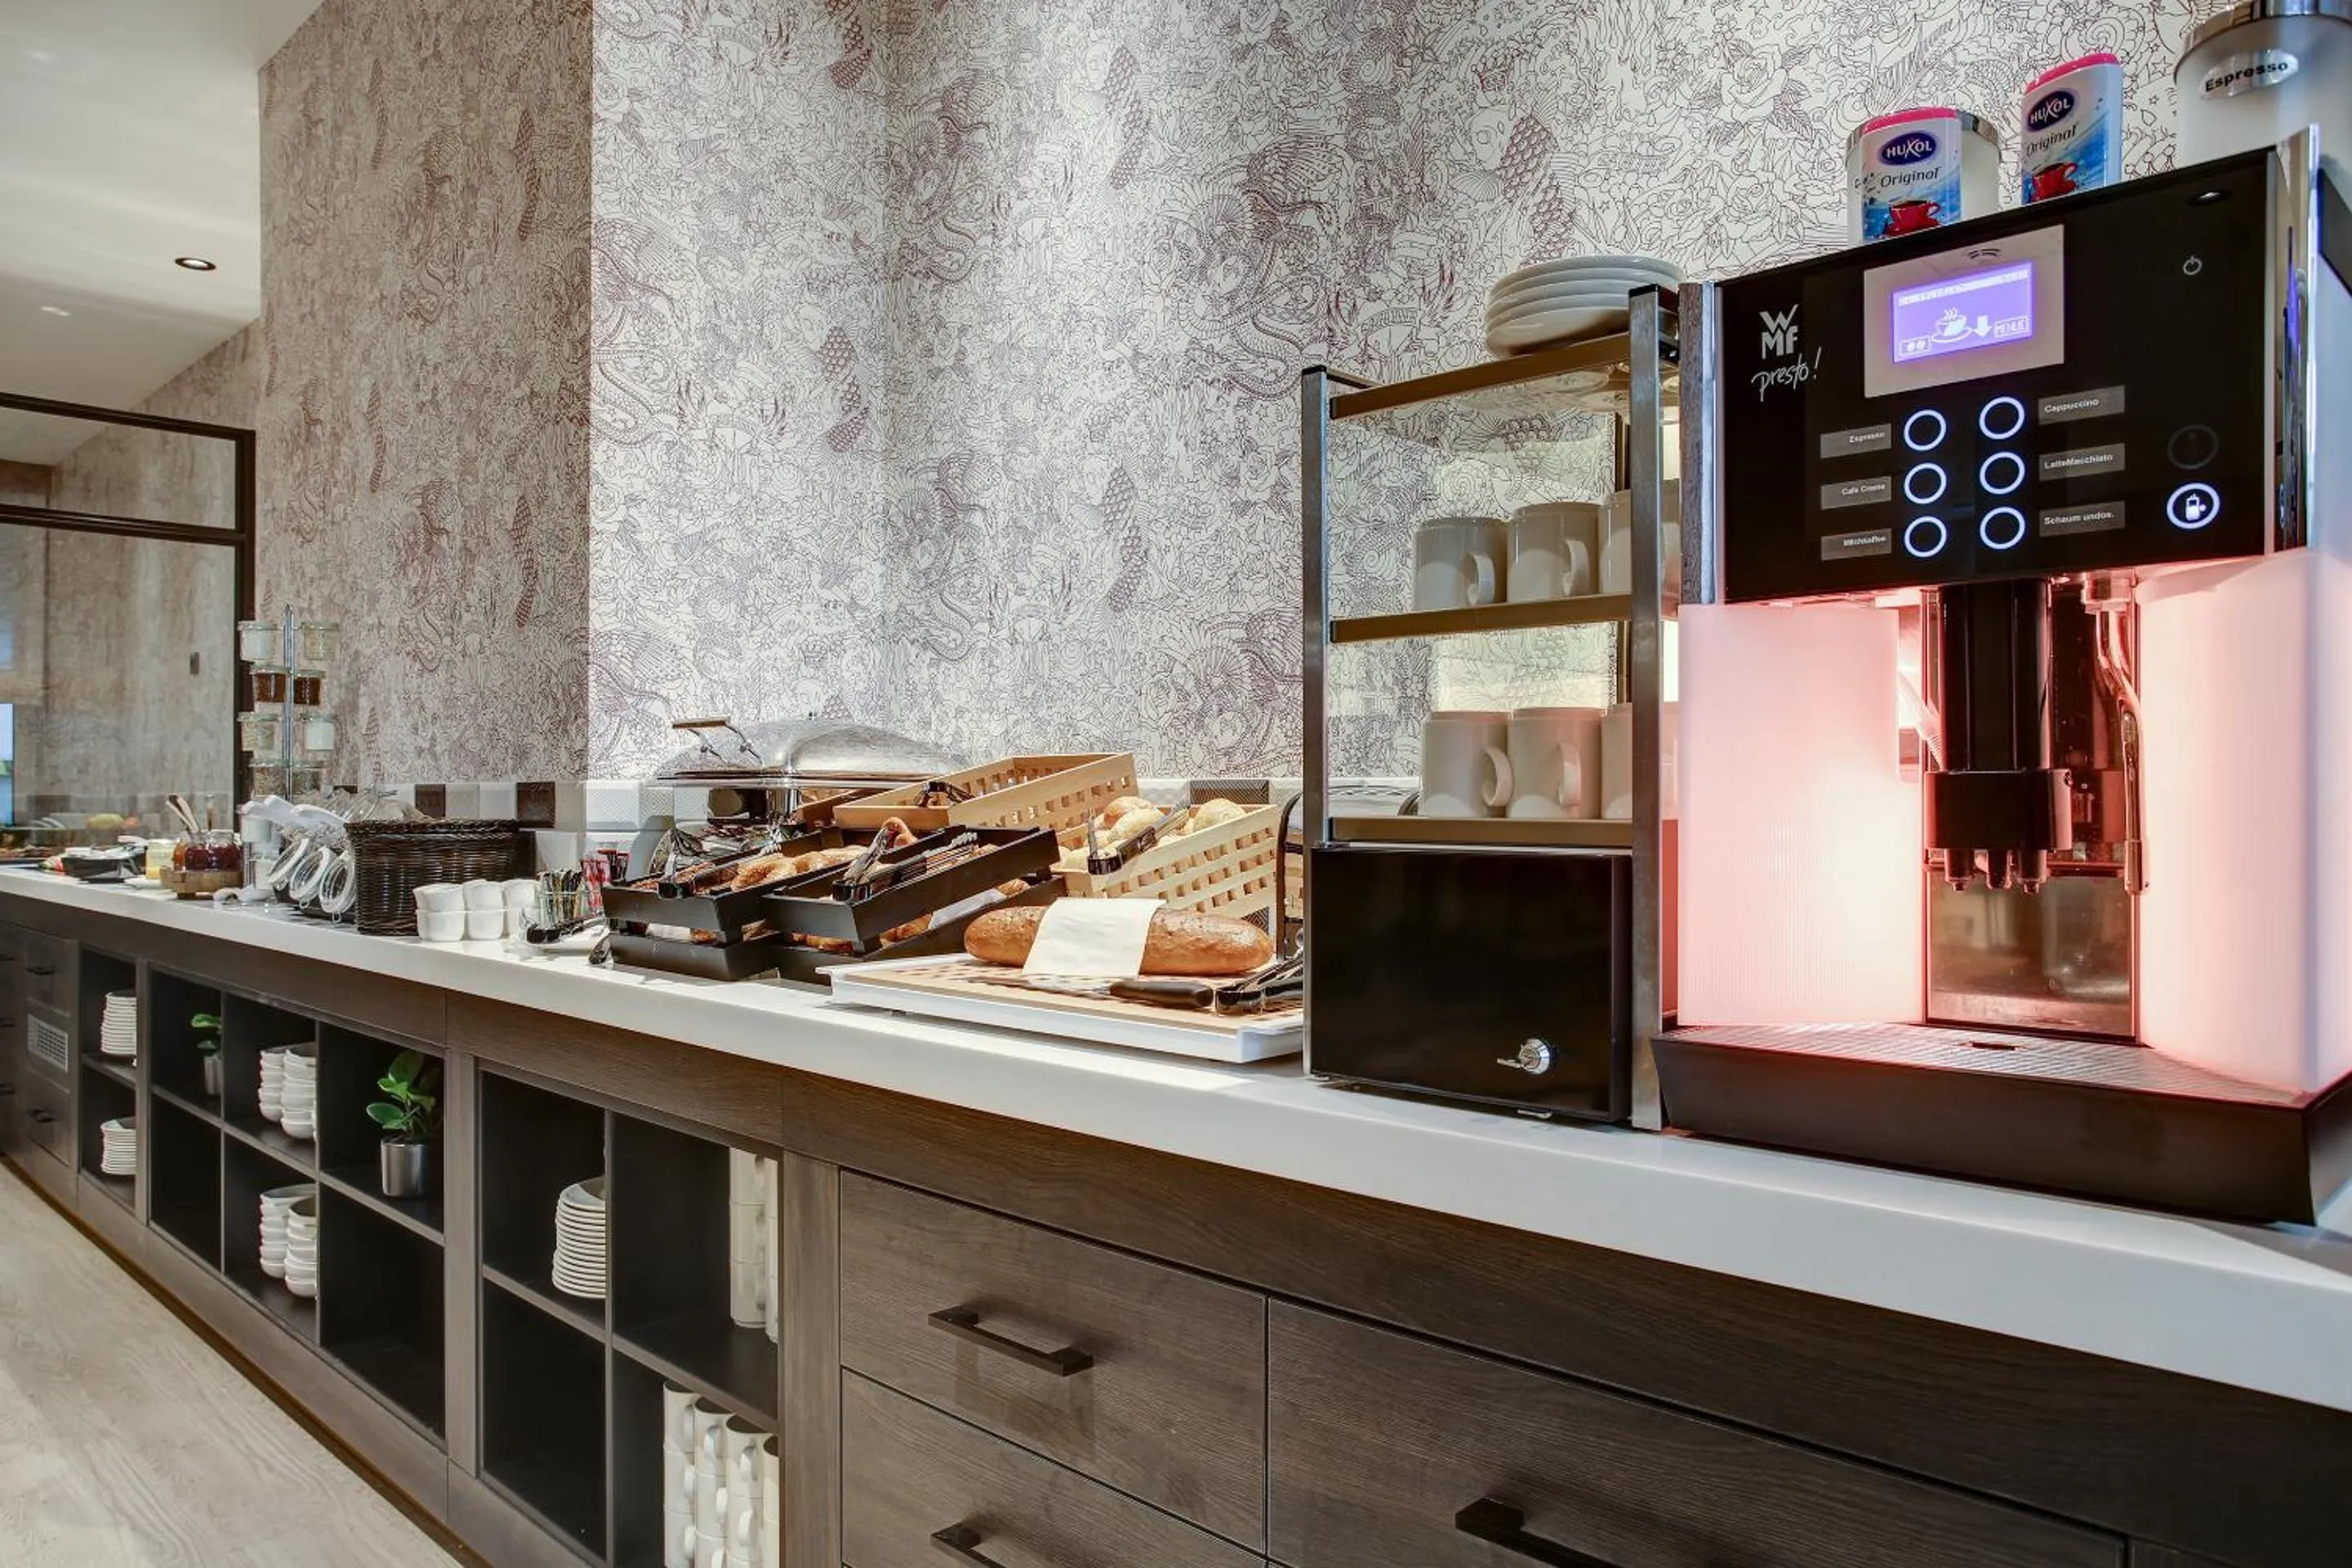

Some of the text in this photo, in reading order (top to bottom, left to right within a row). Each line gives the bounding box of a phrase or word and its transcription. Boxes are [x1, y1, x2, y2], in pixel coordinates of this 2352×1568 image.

[2205, 62, 2288, 92] Espresso
[2029, 97, 2071, 125] HUXOL
[1886, 138, 1933, 159] HUXOL
[2026, 122, 2078, 157] Original
[1880, 166, 1942, 188] Original
[1758, 303, 1799, 360] WMF
[2044, 398, 2100, 413] Cappuccino
